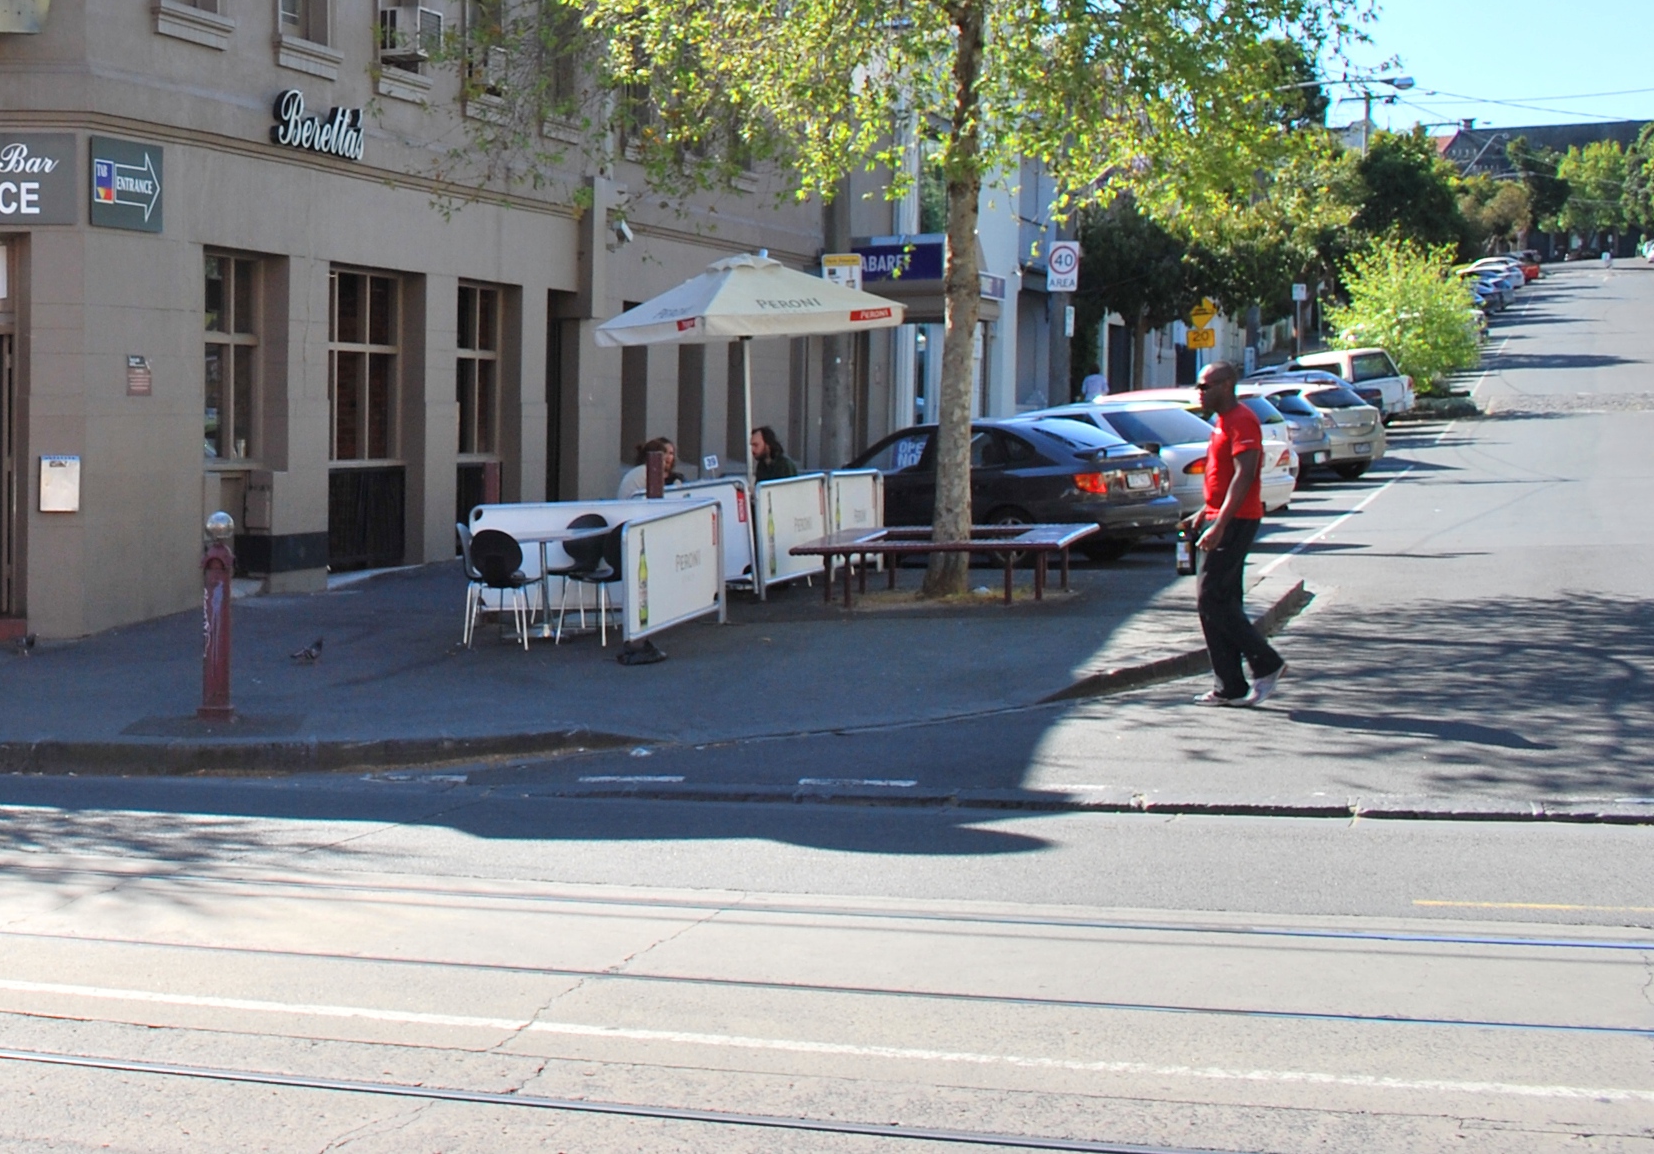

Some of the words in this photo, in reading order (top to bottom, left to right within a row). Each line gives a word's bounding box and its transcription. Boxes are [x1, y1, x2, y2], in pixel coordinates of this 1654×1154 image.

[116, 176, 153, 195] ENTRANCE
[1053, 253, 1074, 267] 40
[1049, 279, 1076, 288] AREA
[756, 297, 823, 310] PERONI
[860, 309, 890, 319] PERONI
[1192, 330, 1210, 342] 20
[899, 442, 926, 453] OPE
[898, 454, 921, 466] NO
